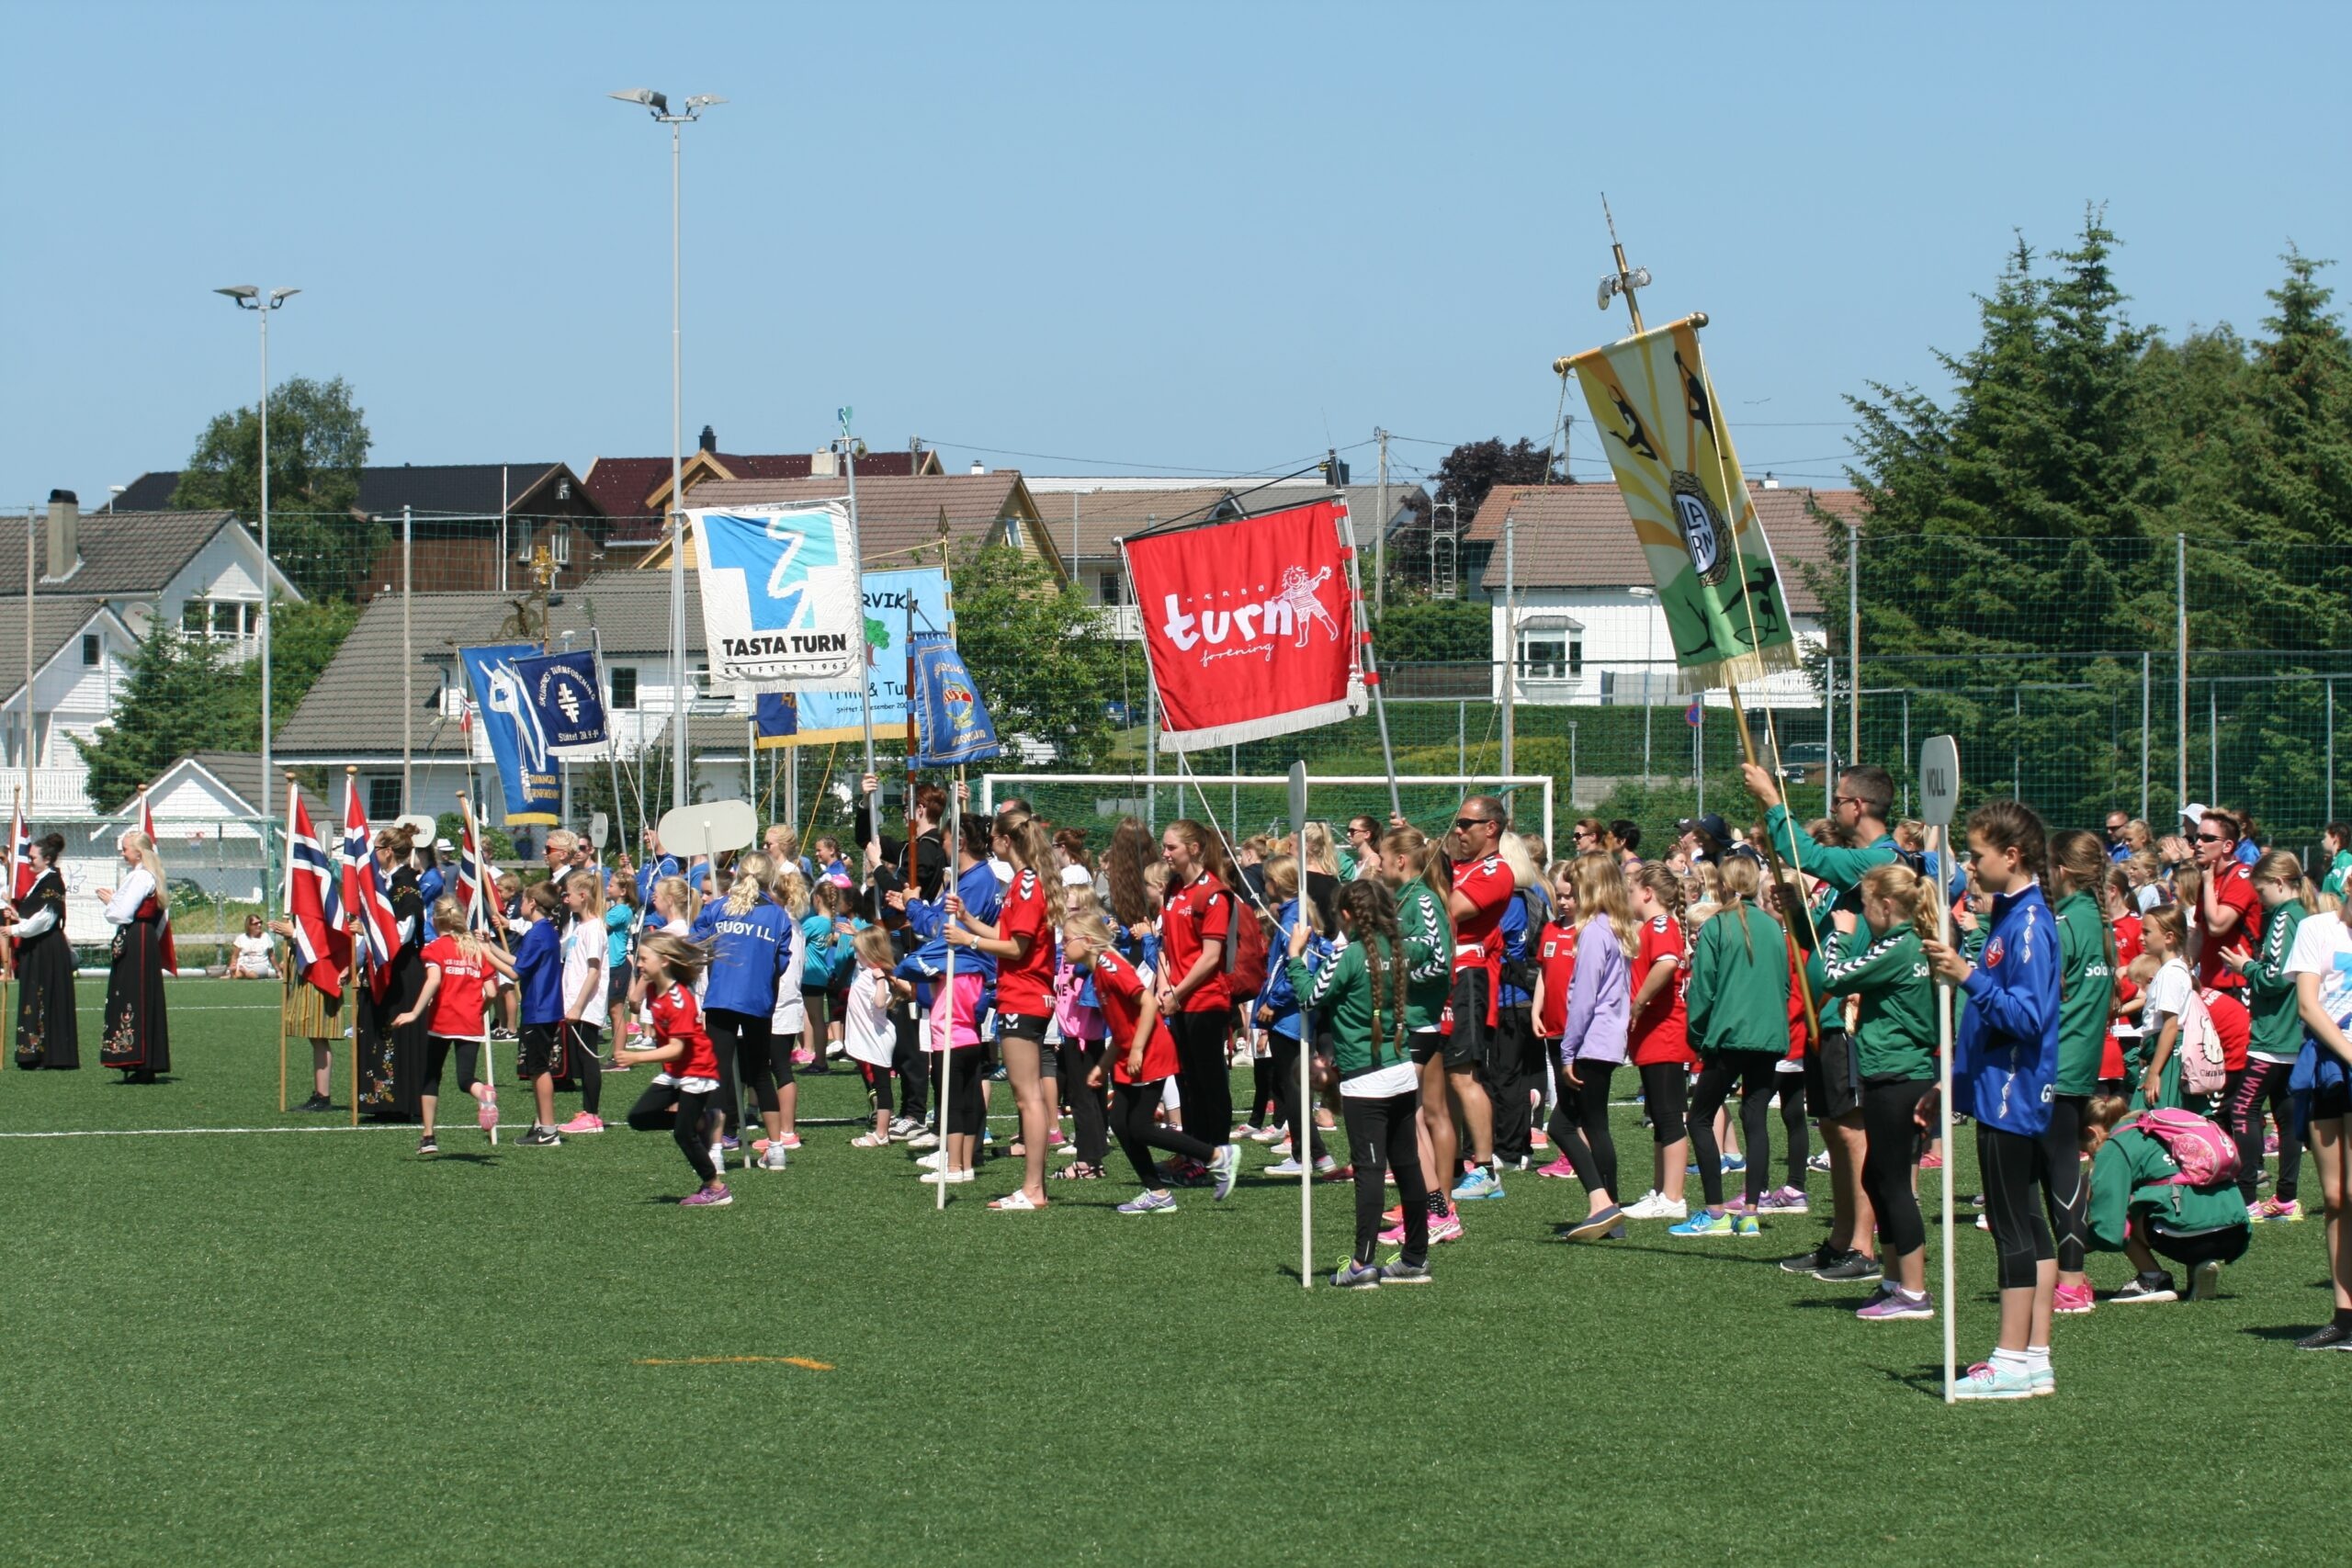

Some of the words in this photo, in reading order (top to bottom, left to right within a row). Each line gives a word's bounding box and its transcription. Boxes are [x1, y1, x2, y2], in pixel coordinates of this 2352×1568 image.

[1186, 584, 1264, 603] NÆRBØ
[1163, 593, 1293, 651] turn
[722, 637, 787, 657] TASTA
[791, 634, 847, 653] TURN
[1200, 642, 1275, 667] forening
[810, 662, 847, 671] 1963
[869, 682, 878, 697] &
[870, 703, 895, 711] esember
[1926, 768, 1946, 797] VOLL
[756, 925, 775, 942] I.L.
[2233, 1119, 2247, 1134] IT
